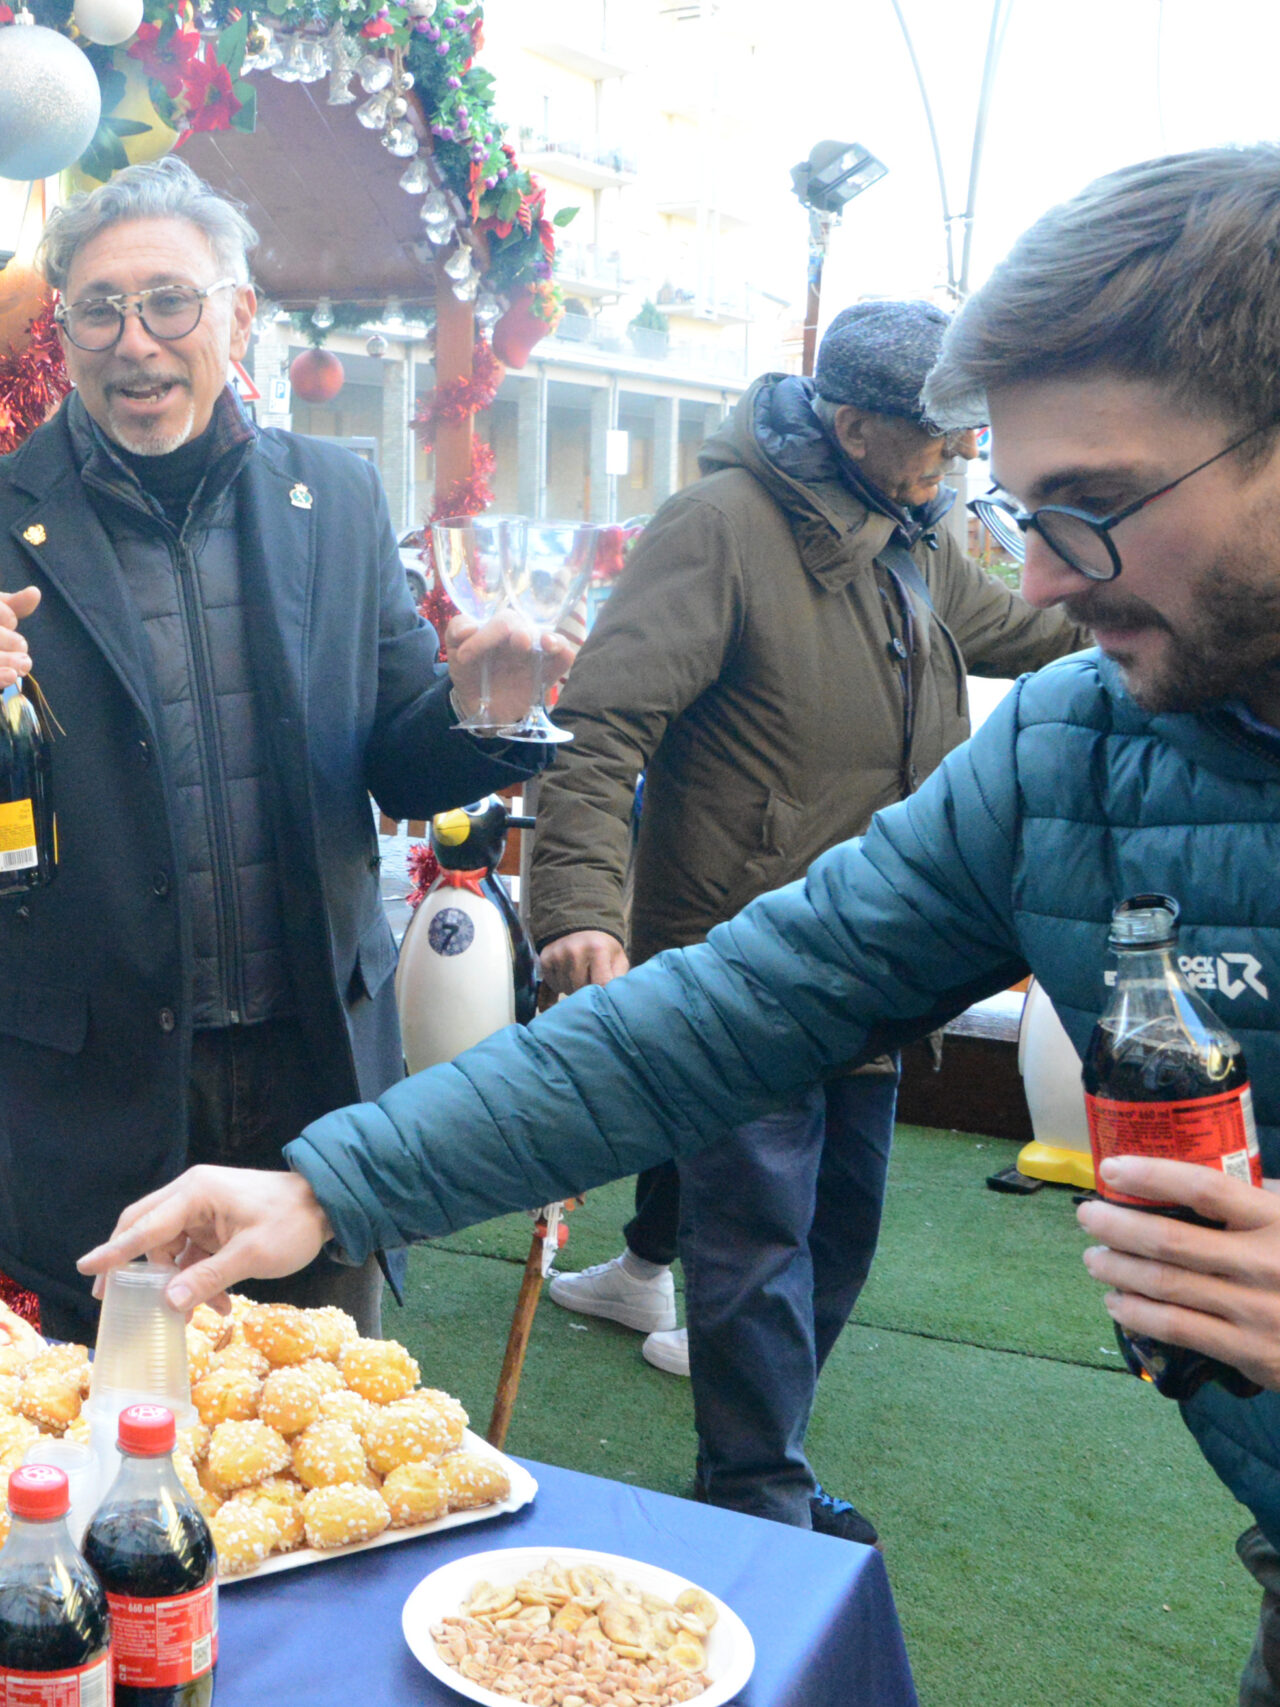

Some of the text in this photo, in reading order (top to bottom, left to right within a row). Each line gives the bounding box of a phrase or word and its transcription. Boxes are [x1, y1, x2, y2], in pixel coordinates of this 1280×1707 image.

[441, 923, 460, 952] 7
[1177, 955, 1215, 973] OCK
[144, 1603, 155, 1614] ml
